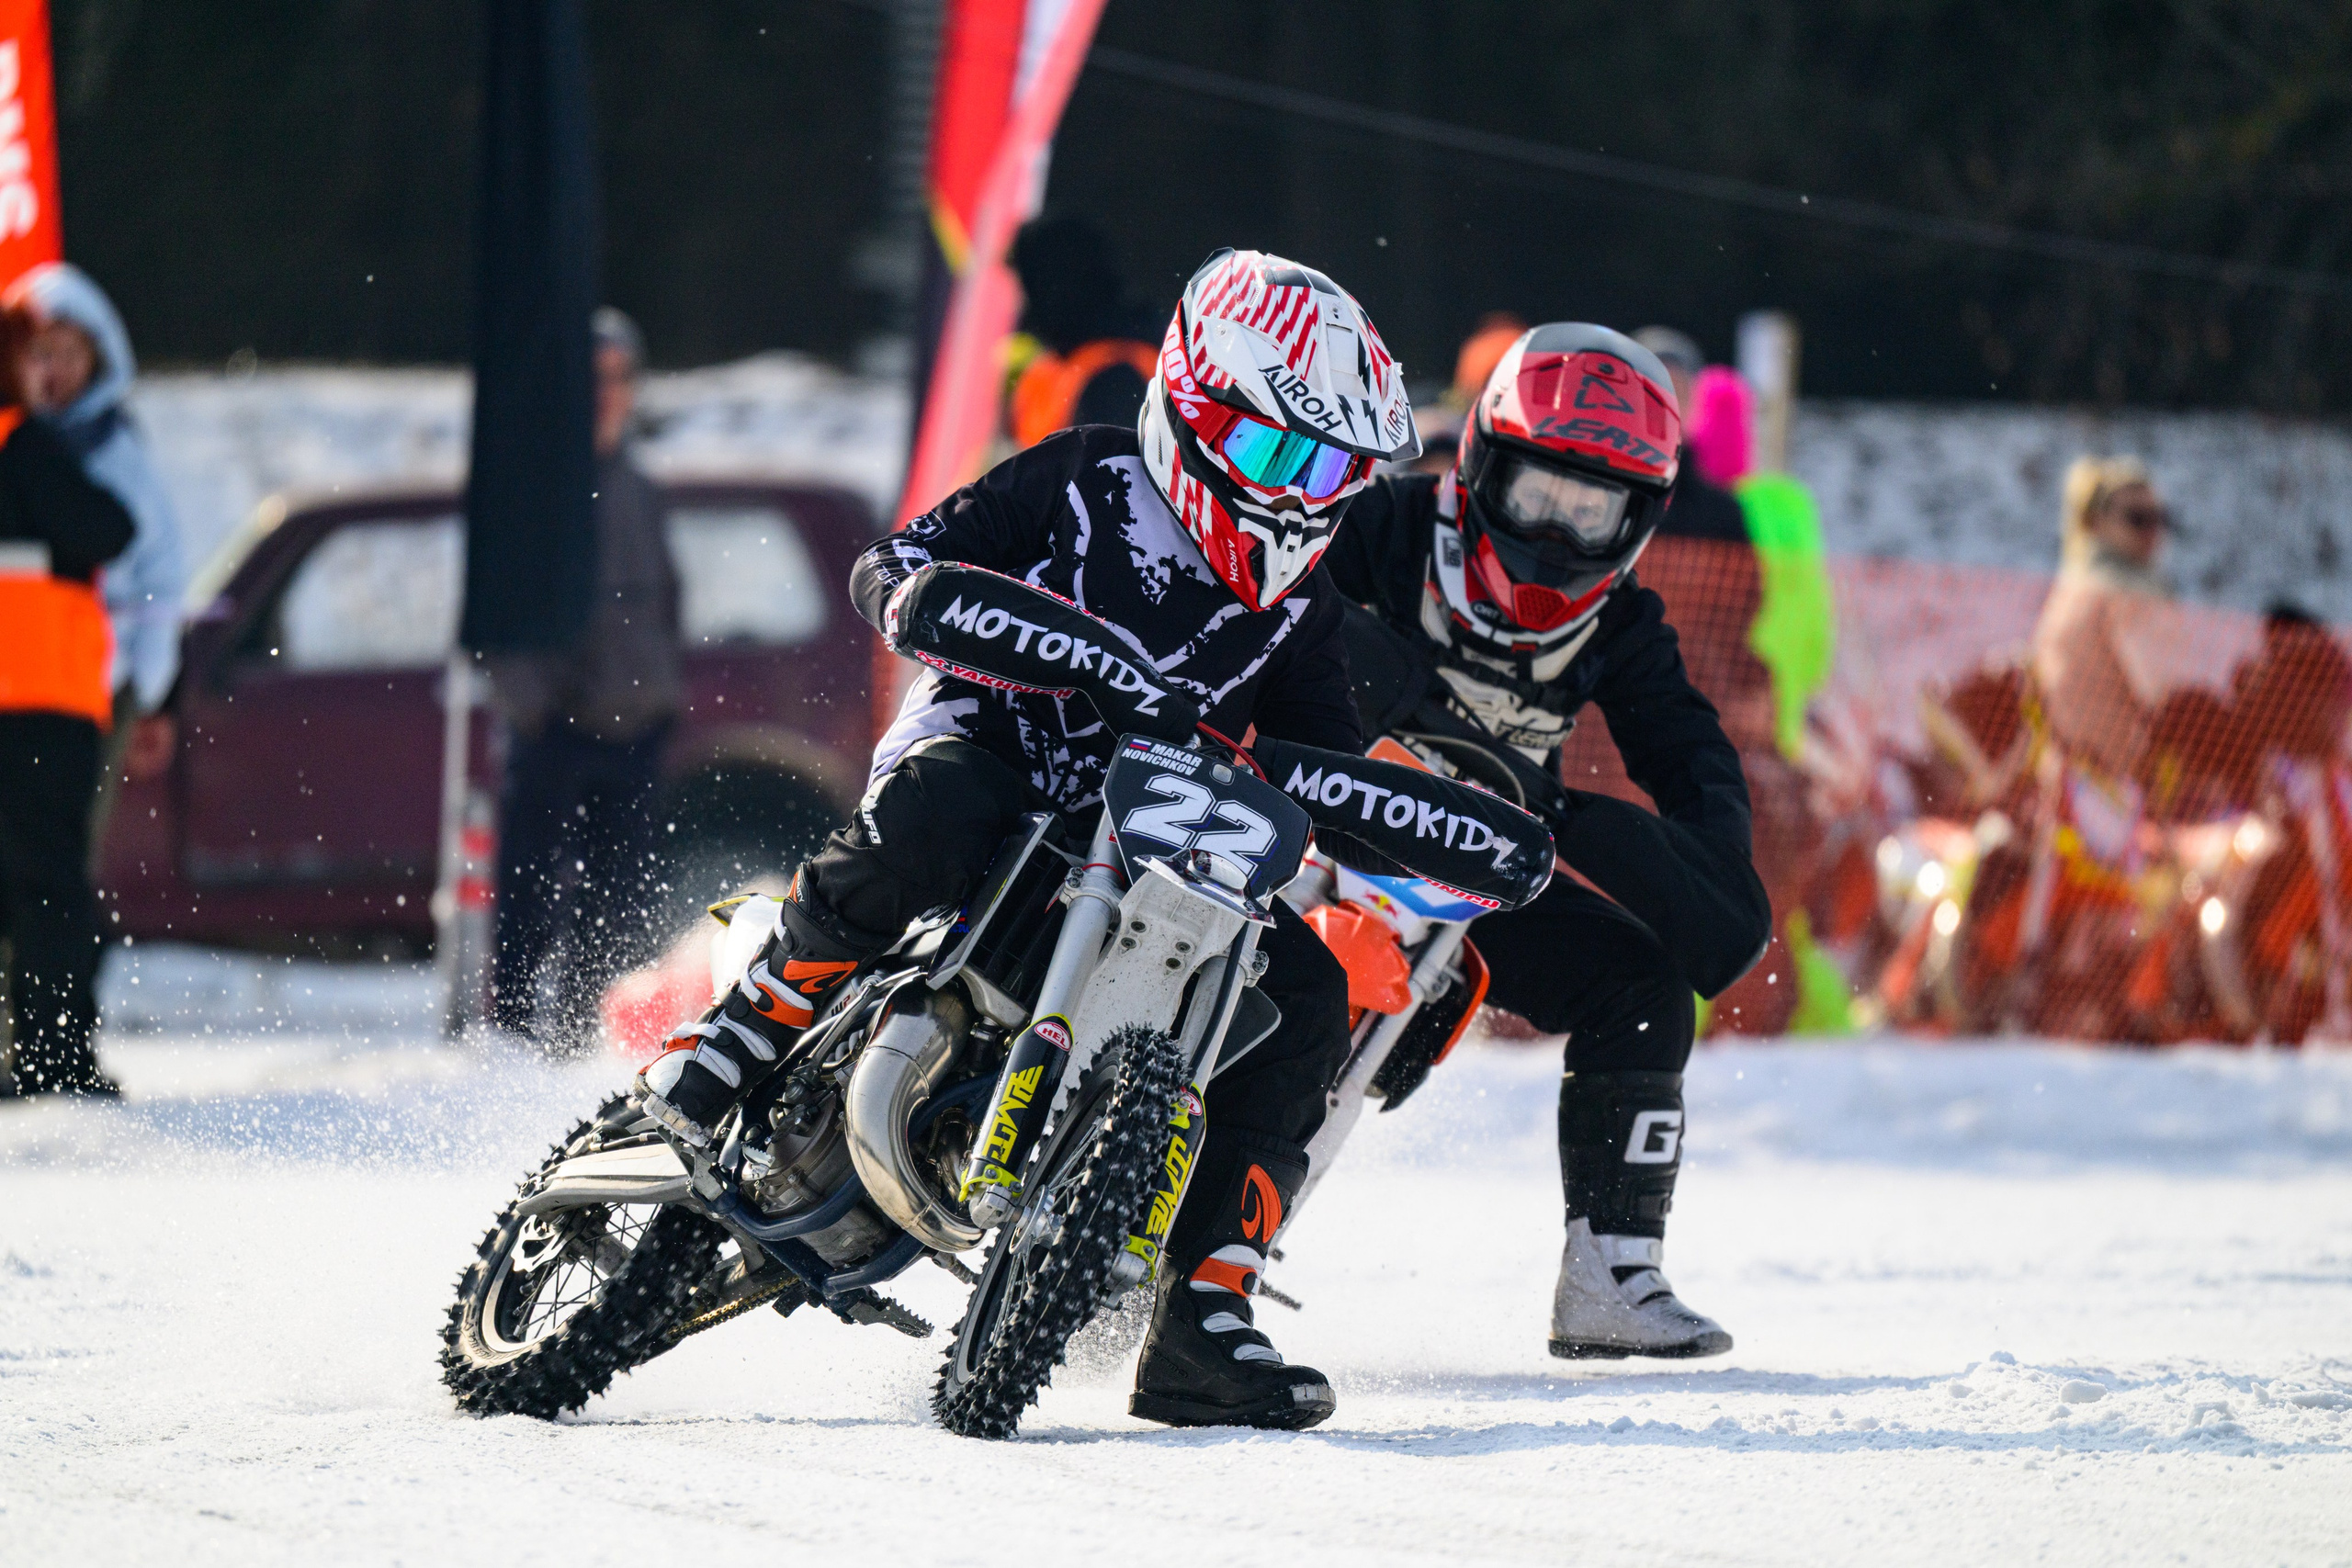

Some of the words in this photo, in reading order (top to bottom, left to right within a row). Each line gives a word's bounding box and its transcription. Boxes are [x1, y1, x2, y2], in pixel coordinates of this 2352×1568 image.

[1163, 310, 1210, 420] 00%
[1258, 364, 1342, 432] AIROH
[1531, 416, 1670, 465] LEATT
[875, 565, 900, 588] TOP
[1227, 538, 1239, 582] AIROH
[939, 594, 1171, 716] MOTOKIDZ
[1122, 748, 1196, 775] NOVICHKOV
[1150, 743, 1203, 768] MAKAR
[862, 808, 882, 844] UFO
[1120, 773, 1278, 880] 22
[1283, 762, 1518, 869] MOTOKIDZ
[831, 995, 851, 1017] WP
[1043, 1027, 1068, 1048] HEL
